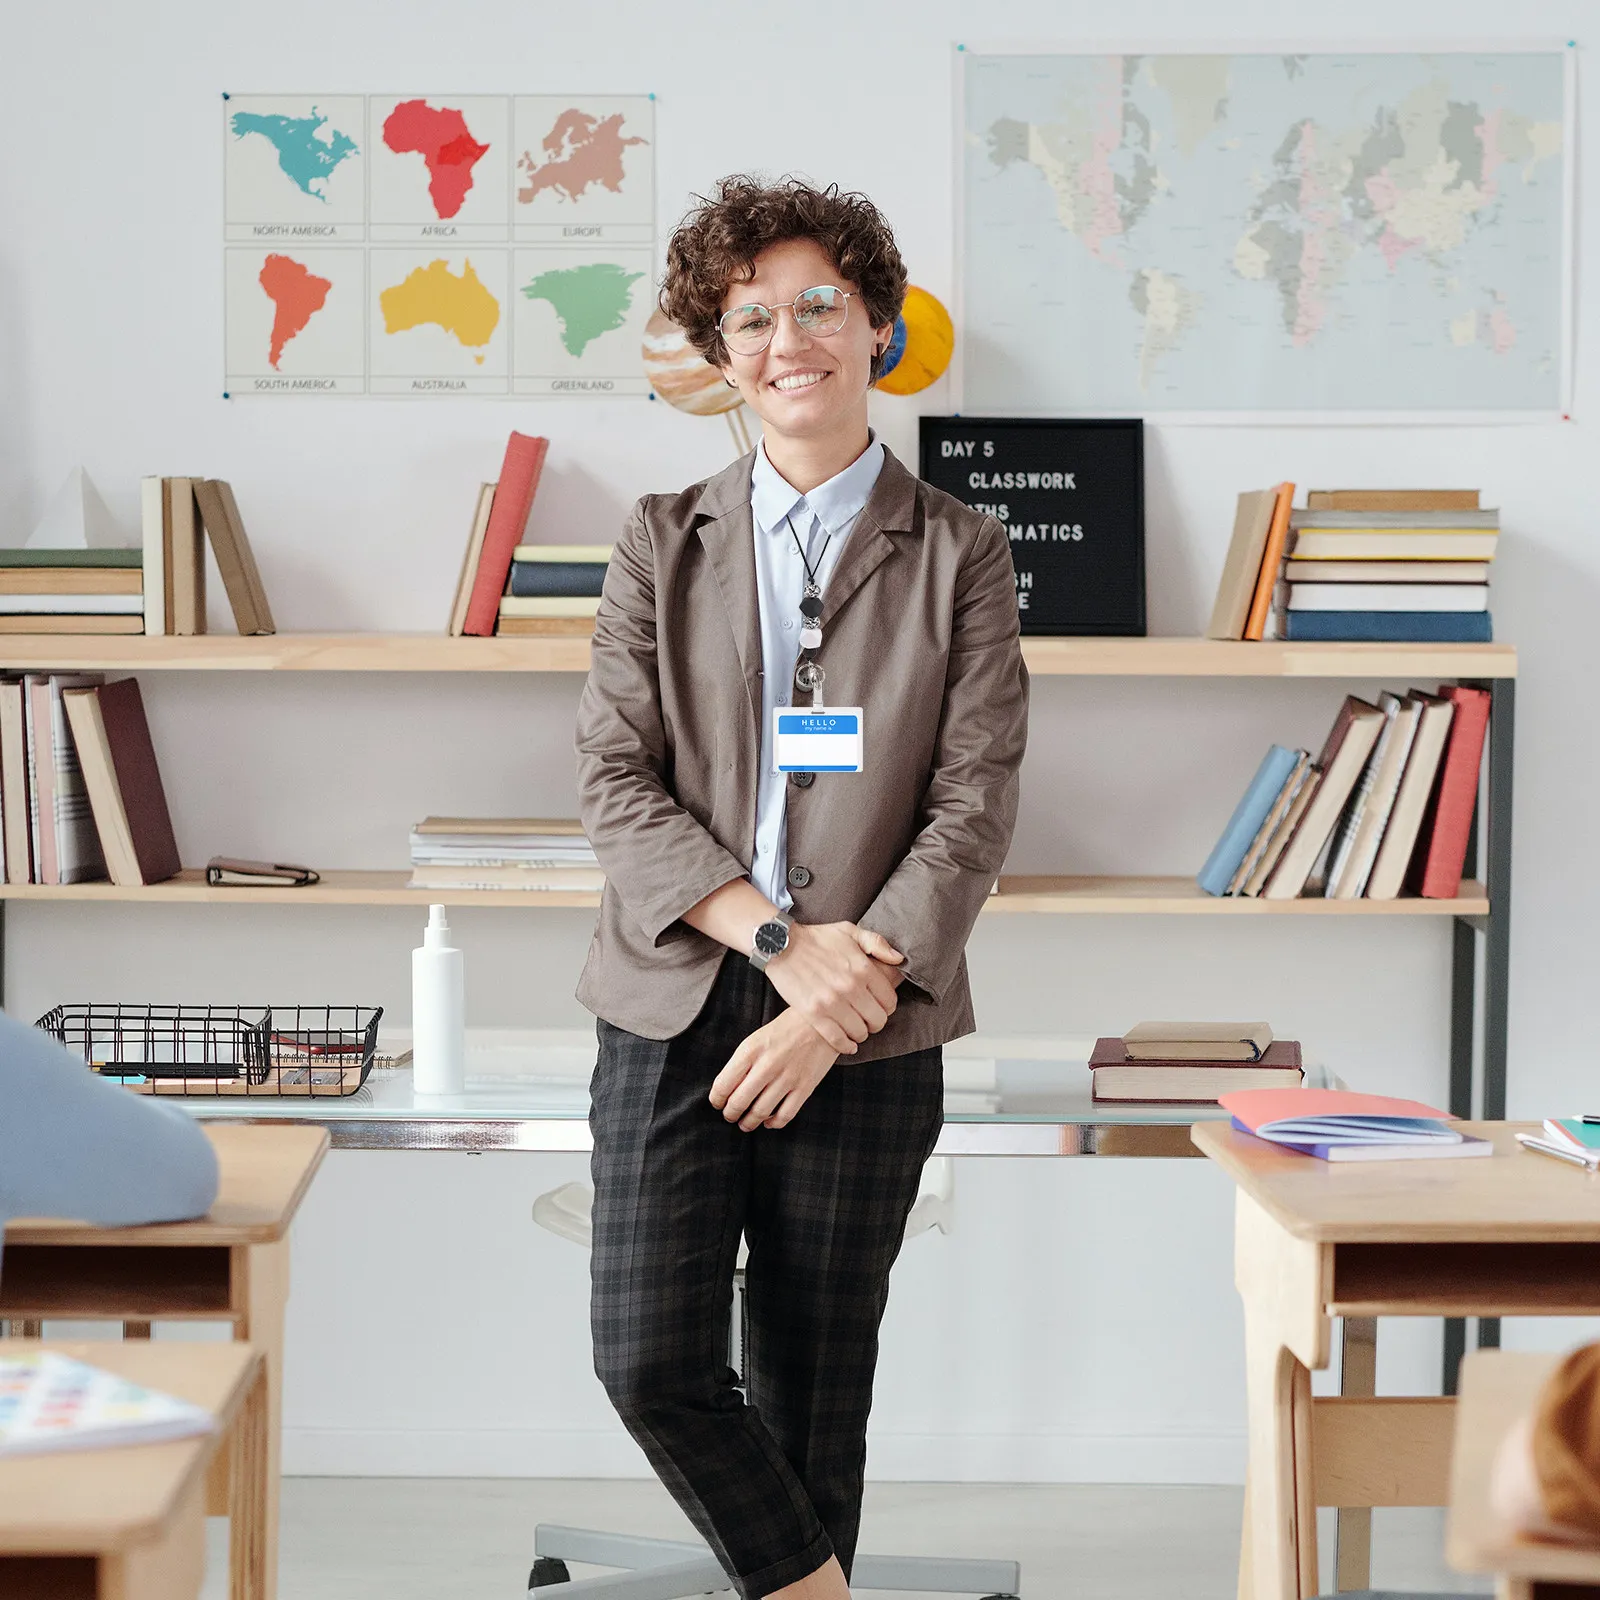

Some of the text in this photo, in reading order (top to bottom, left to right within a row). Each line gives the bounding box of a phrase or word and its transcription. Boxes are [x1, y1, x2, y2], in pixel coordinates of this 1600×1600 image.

[253, 226, 337, 236] NORTH AMERICA
[421, 226, 457, 236] AFRICA
[562, 227, 602, 237] EUROPE
[254, 379, 337, 389] SOUTH AMERICA
[412, 380, 467, 390] AUSTRALIA
[551, 380, 614, 391] GREENLAND
[941, 441, 995, 458] DAY 5
[968, 472, 1077, 490] CLASSWORK
[967, 503, 1010, 521] THS
[1002, 523, 1084, 541] MATICS
